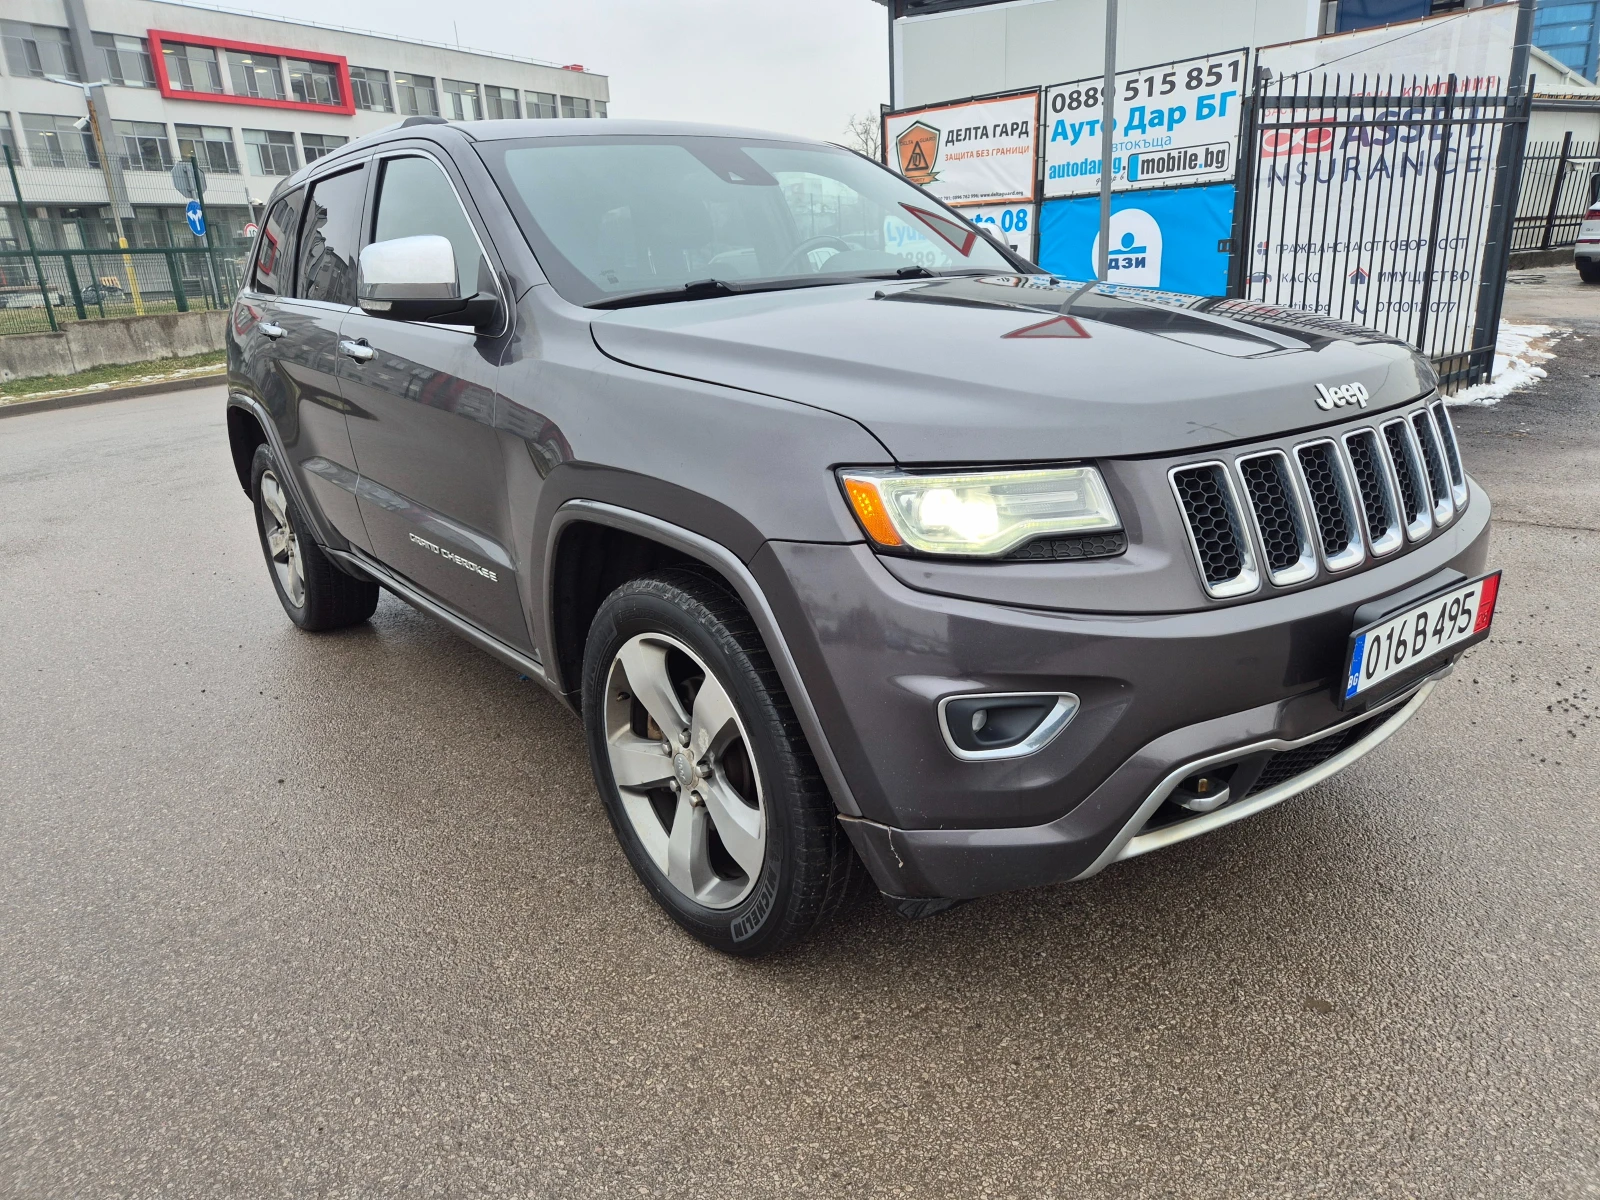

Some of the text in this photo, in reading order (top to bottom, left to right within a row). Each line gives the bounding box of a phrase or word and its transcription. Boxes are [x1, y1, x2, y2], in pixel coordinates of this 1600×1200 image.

[1124, 72, 1176, 101] 515
[1185, 60, 1240, 90] 851
[1402, 75, 1496, 97] КОМПНИЯ
[1123, 104, 1186, 137] Дар
[1196, 90, 1237, 121] БГ
[945, 121, 1029, 147] ДЕЛТА ГАРД
[1339, 104, 1481, 150] ASSET
[945, 145, 1030, 161] ЗАЩИТА БЕЗ ГРАНИЦИ
[1111, 135, 1172, 152] втокъща
[1049, 148, 1226, 180] autodarg. mobile.bg
[1267, 145, 1484, 189] NSURANCE
[1001, 208, 1028, 233] 08
[1275, 238, 1467, 255] ГРАЖДАНСКА ОТГОВОРОСТ
[1108, 257, 1146, 270] ДЗИ
[1281, 272, 1321, 283] КАСКО
[1314, 382, 1369, 411] Jeep
[409, 532, 498, 582] GRAND CHEROKEE
[1347, 672, 1359, 688] BG
[733, 864, 778, 939] MICHELIN
